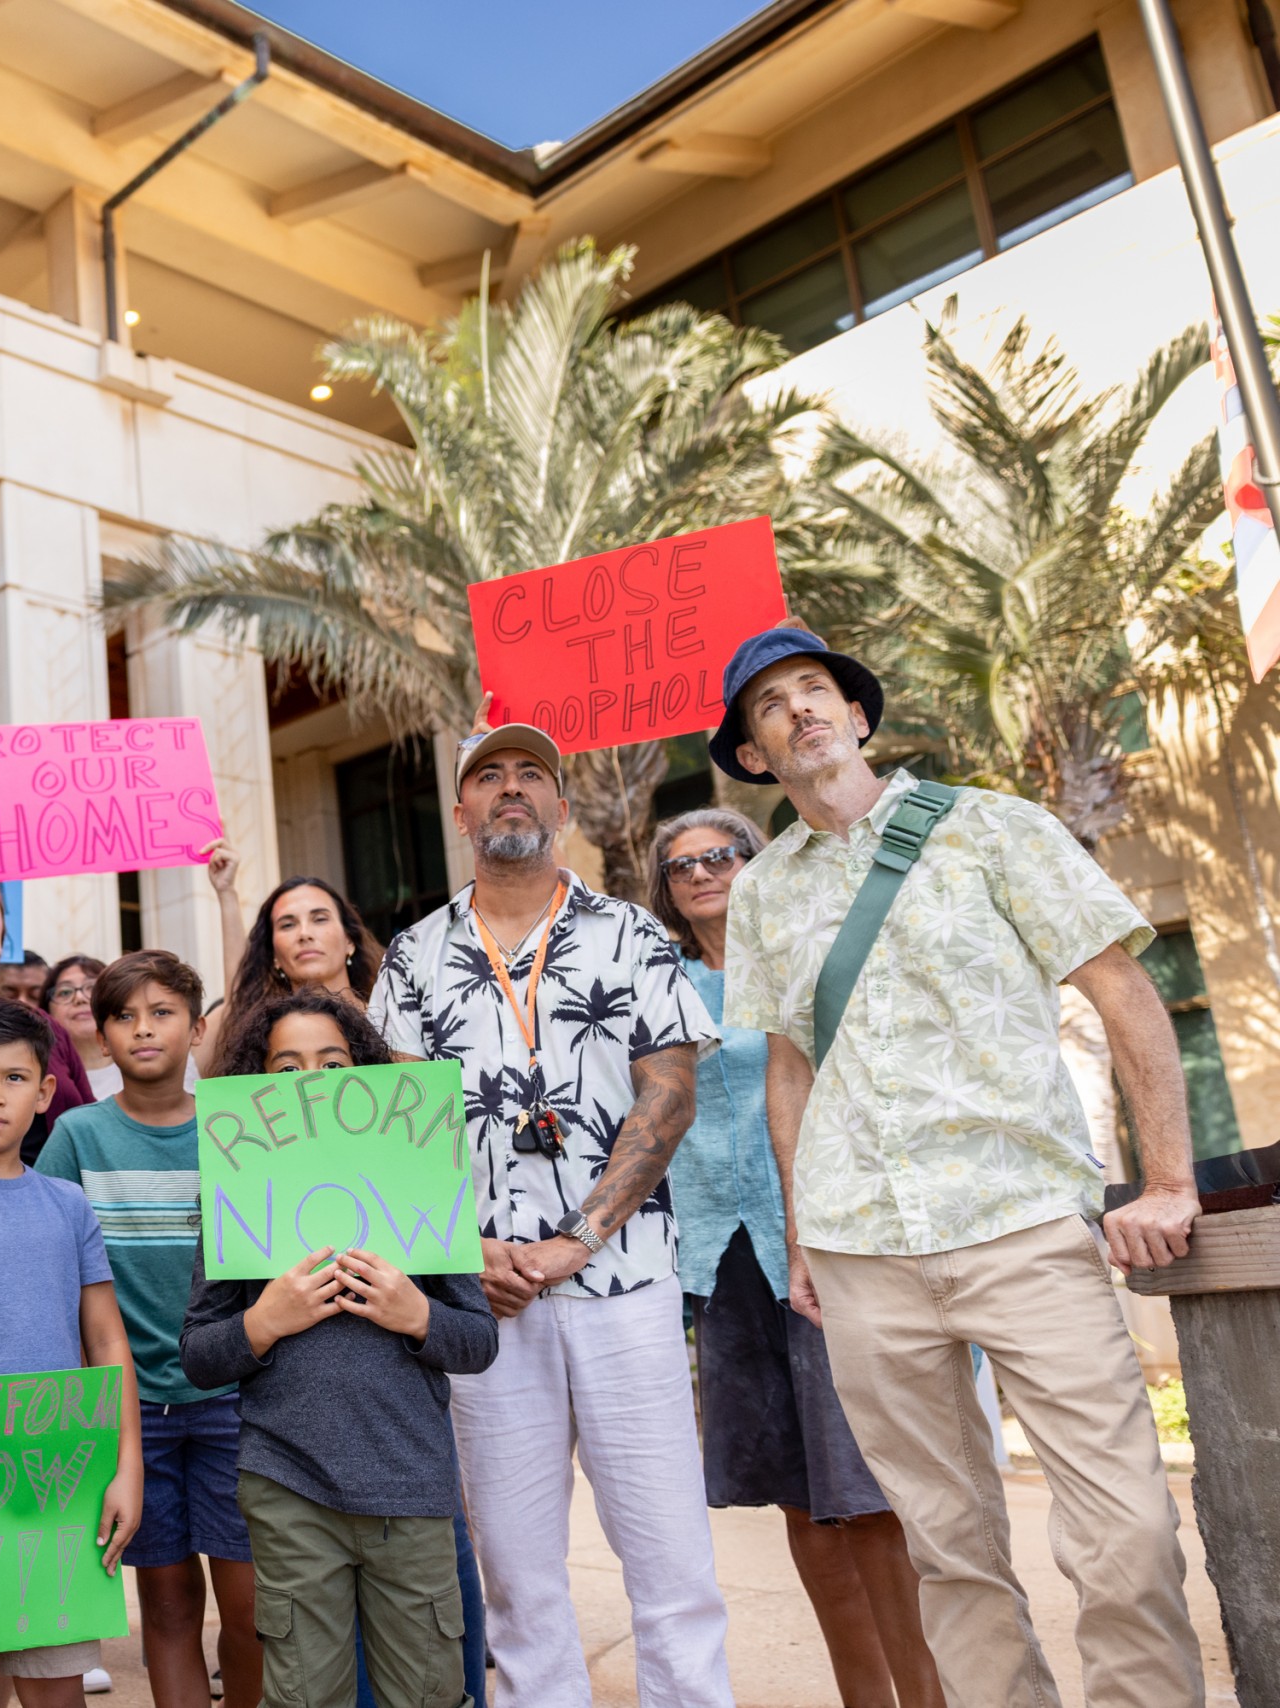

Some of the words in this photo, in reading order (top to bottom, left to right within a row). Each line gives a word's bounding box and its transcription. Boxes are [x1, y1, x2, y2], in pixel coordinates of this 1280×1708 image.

[493, 540, 707, 644] CLOSE
[566, 606, 705, 684] THE
[504, 670, 726, 743] OOPHOL
[32, 755, 160, 798] OUR
[204, 1070, 466, 1172] REFORM
[214, 1173, 468, 1264] NOW
